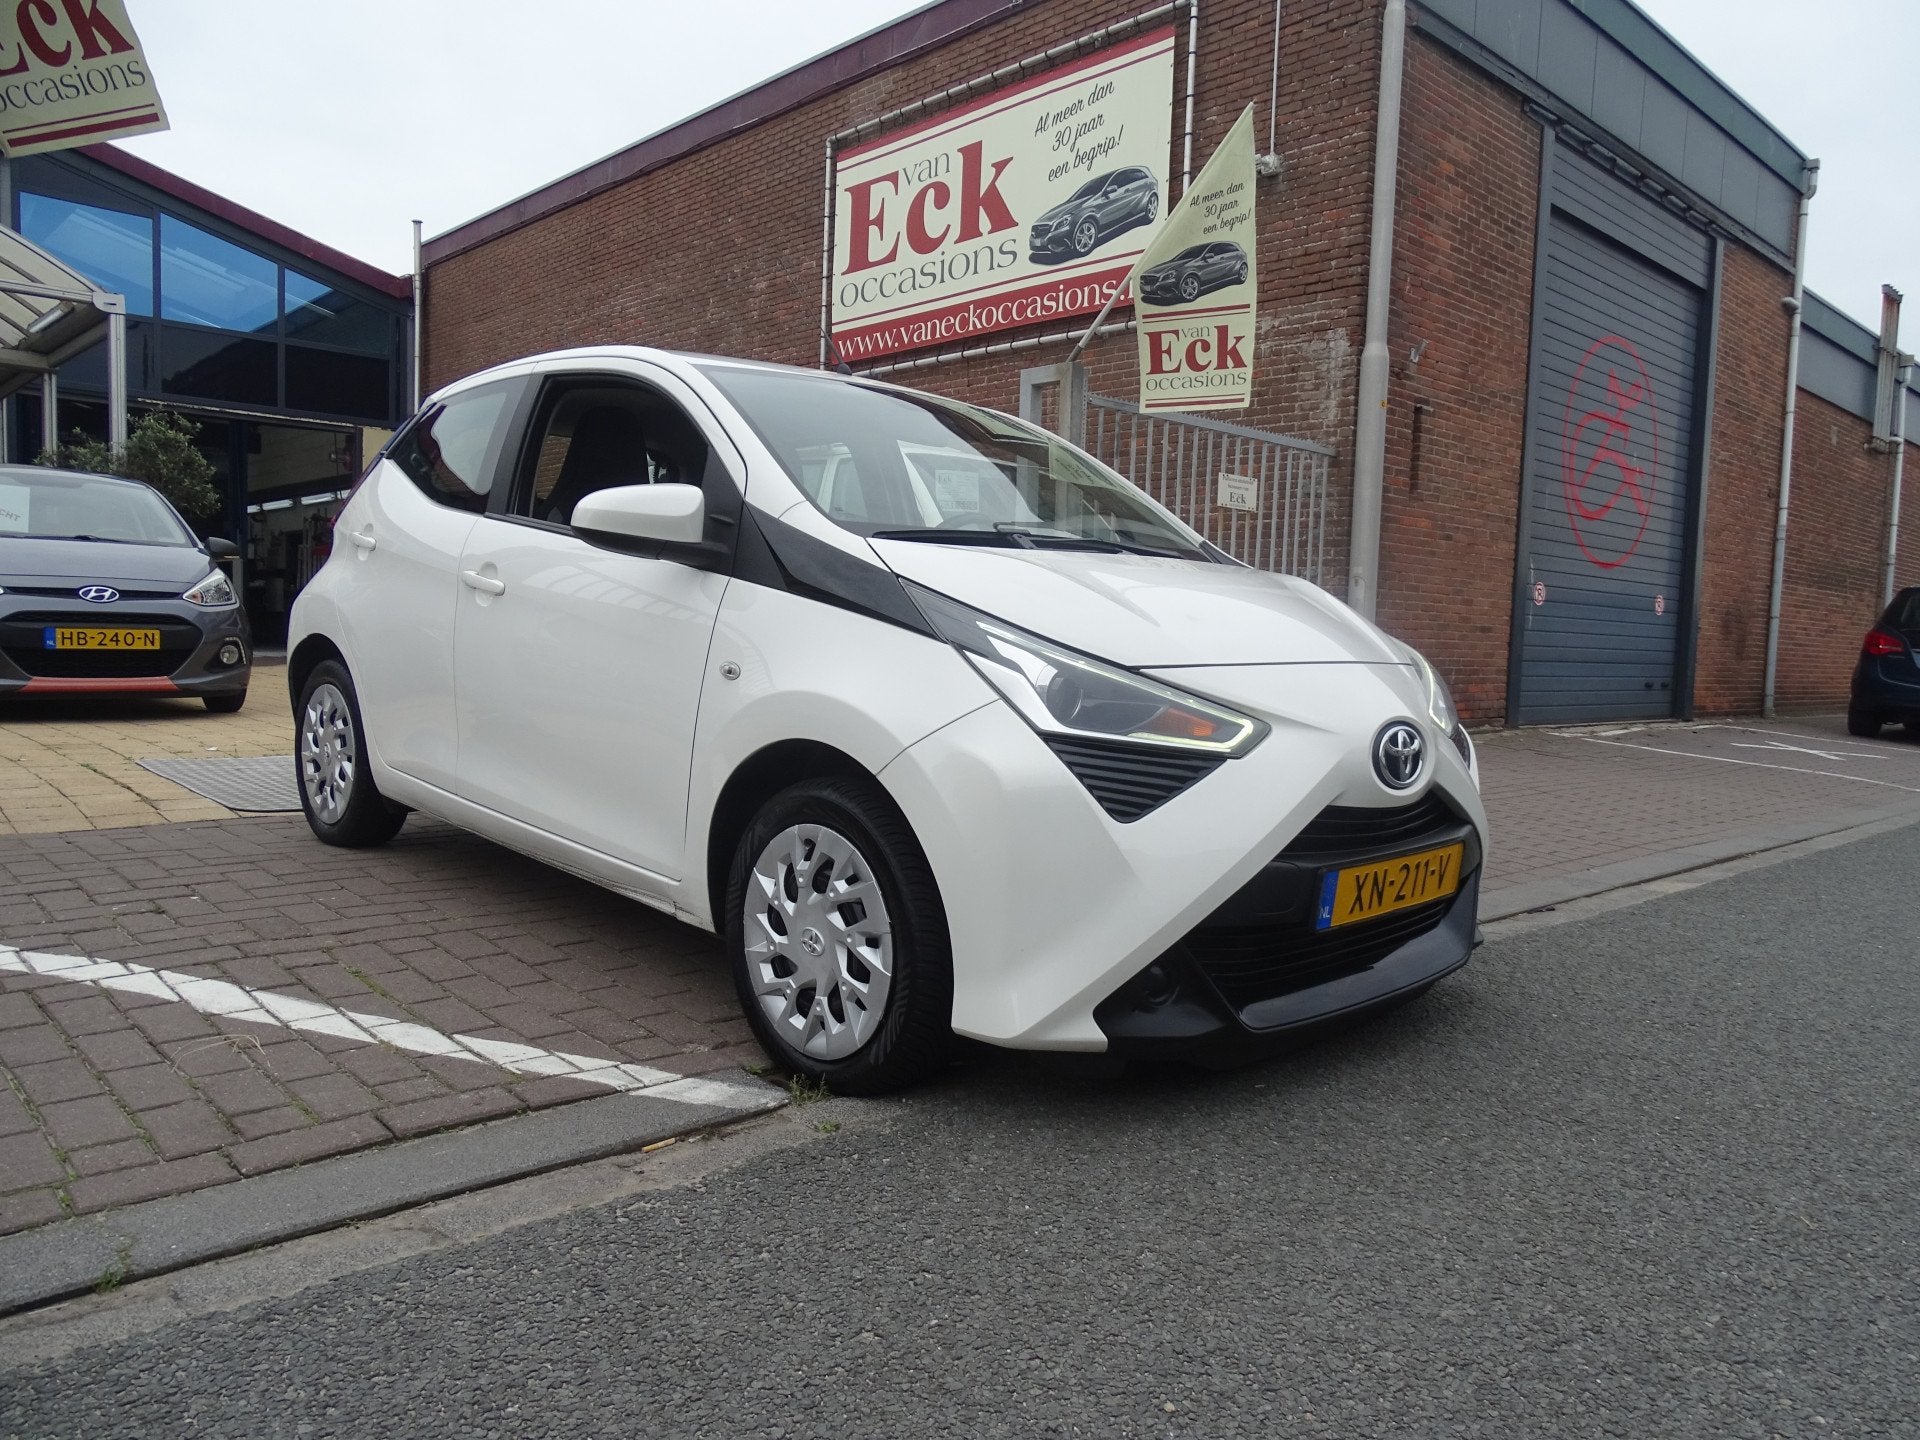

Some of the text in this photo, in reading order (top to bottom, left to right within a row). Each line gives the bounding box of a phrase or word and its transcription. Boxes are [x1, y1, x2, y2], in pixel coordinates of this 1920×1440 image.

[1034, 81, 1114, 138] Al meer dan
[1052, 113, 1104, 153] 30 jaar
[902, 152, 950, 186] van
[1048, 124, 1124, 182] een begrip!
[841, 140, 1019, 276] Eck
[1190, 182, 1244, 208] Al meer dan
[1204, 200, 1239, 219] 30 jaar
[1203, 207, 1251, 234] een begrip!
[840, 238, 1018, 308] occasions
[1143, 325, 1248, 375] Eck
[1181, 326, 1210, 338] van
[1146, 371, 1247, 391] occasions
[61, 631, 155, 647] HB-240-N
[1320, 853, 1451, 918] NL XN-211-V
